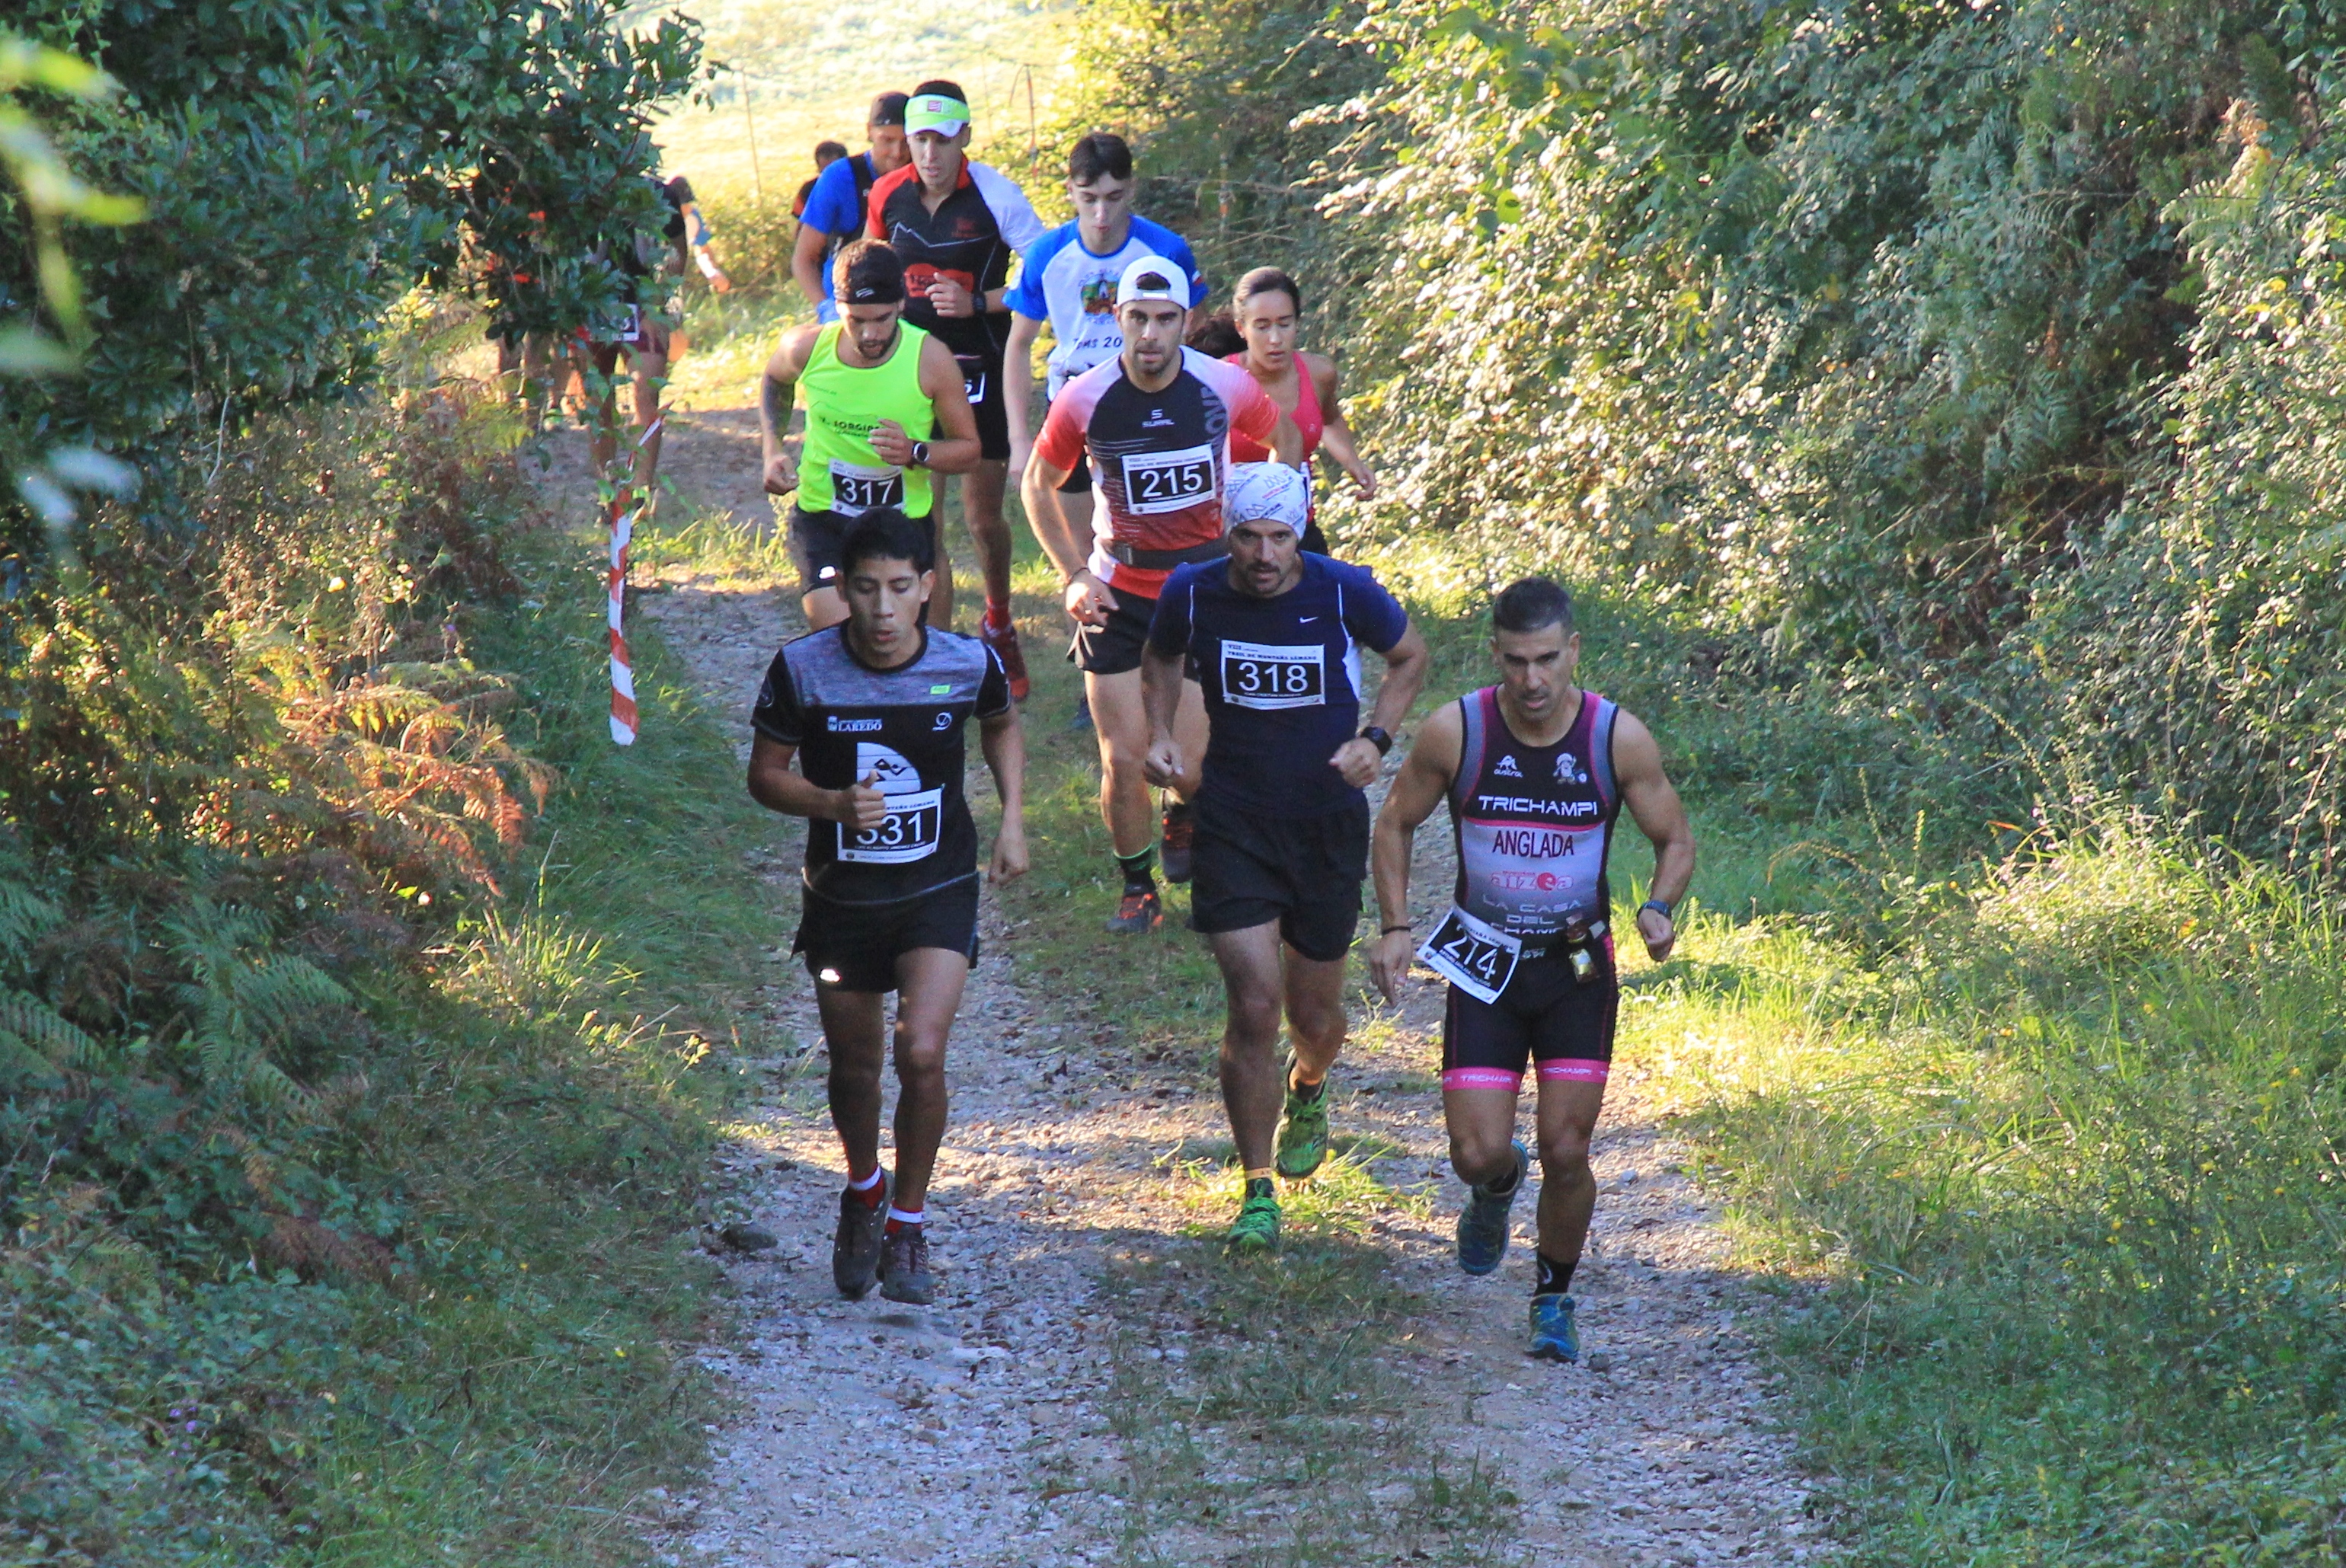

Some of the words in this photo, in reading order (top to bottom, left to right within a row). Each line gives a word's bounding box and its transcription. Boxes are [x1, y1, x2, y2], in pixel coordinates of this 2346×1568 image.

[841, 477, 895, 506] 317
[1140, 464, 1203, 498] 215
[1239, 661, 1309, 693] 318
[838, 720, 883, 732] LAREDO
[1478, 794, 1598, 817] TRICHAMPI
[1492, 829, 1574, 858] ANGLADA
[1482, 893, 1510, 911] LA
[1519, 899, 1582, 913] CASA
[1506, 914, 1555, 925] DEL
[1442, 923, 1497, 980] 214
